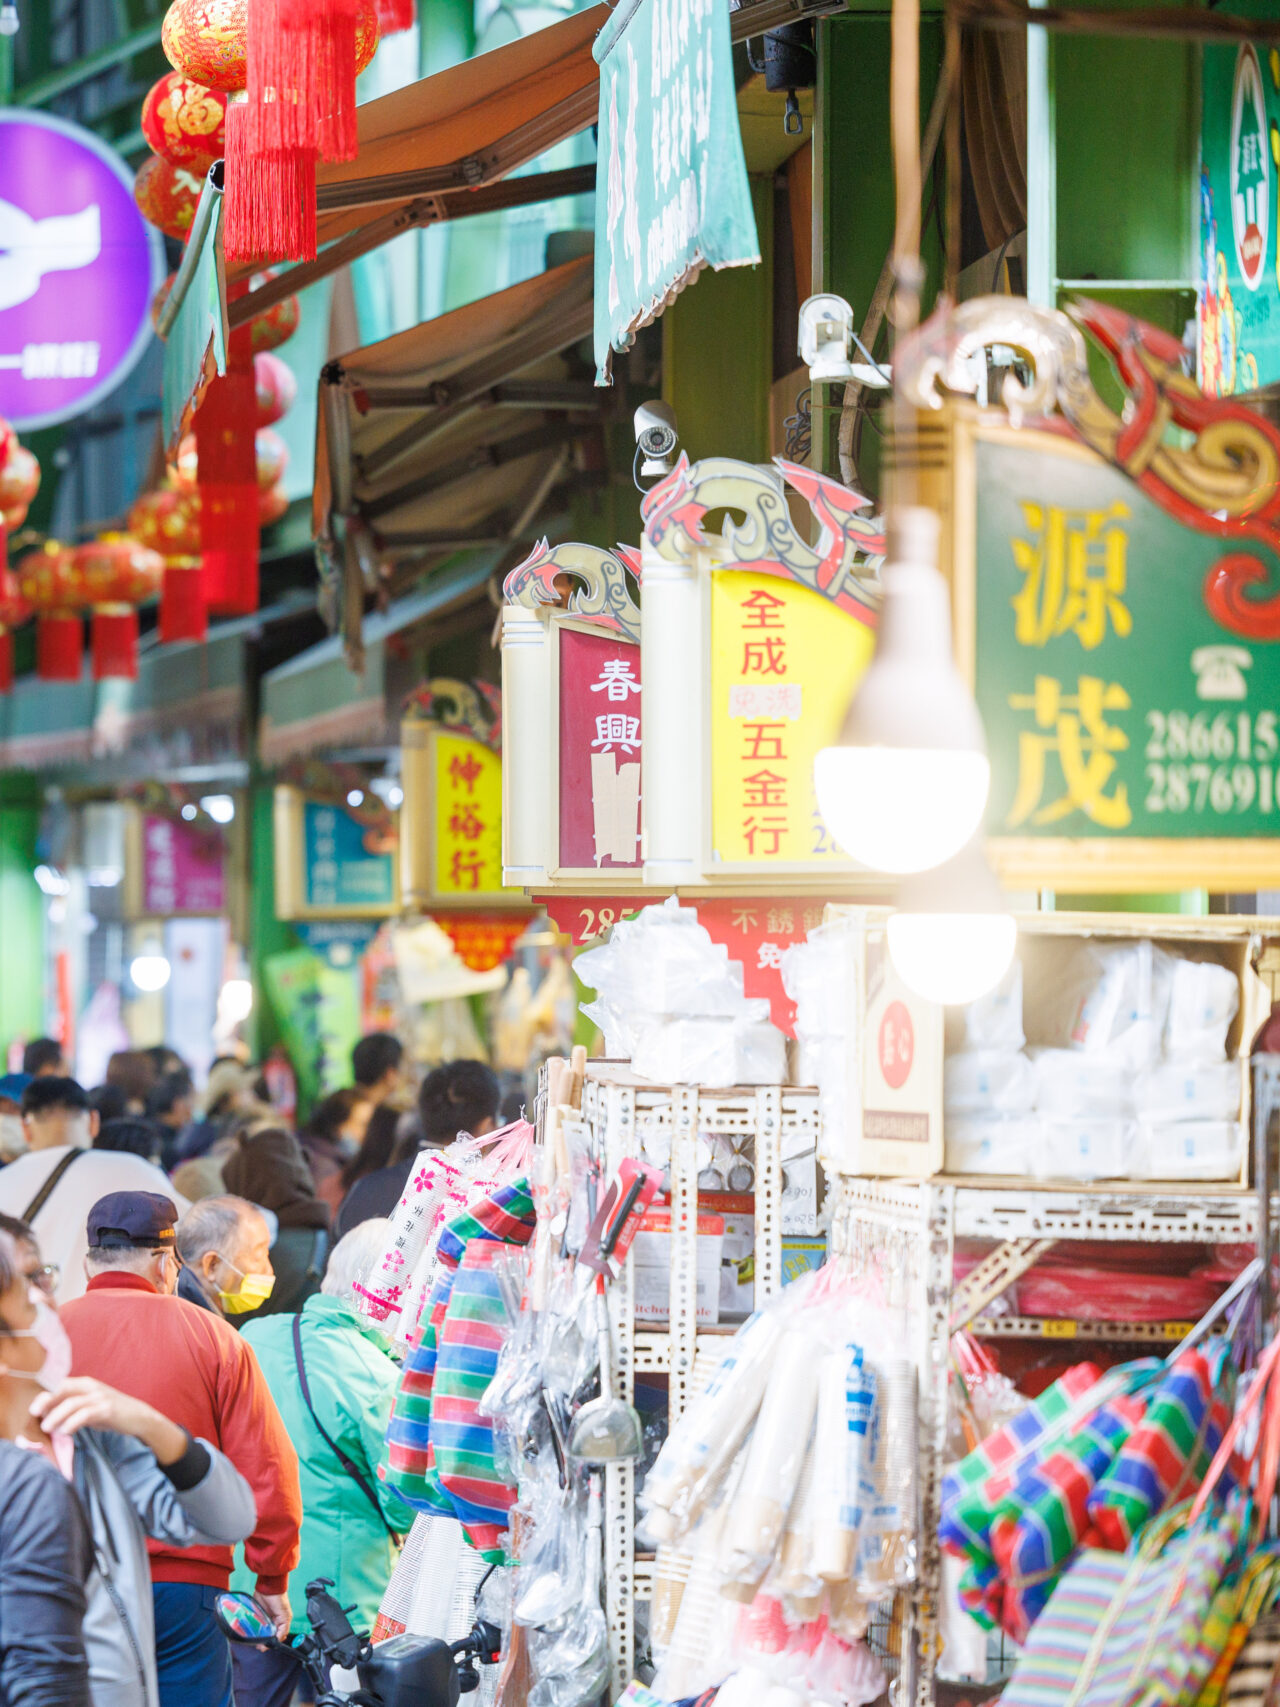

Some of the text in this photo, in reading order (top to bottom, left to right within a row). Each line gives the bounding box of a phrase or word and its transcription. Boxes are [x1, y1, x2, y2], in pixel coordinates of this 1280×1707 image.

[590, 659, 642, 755] 春興
[1008, 500, 1132, 829] 源茂
[1144, 764, 1280, 814] 287691
